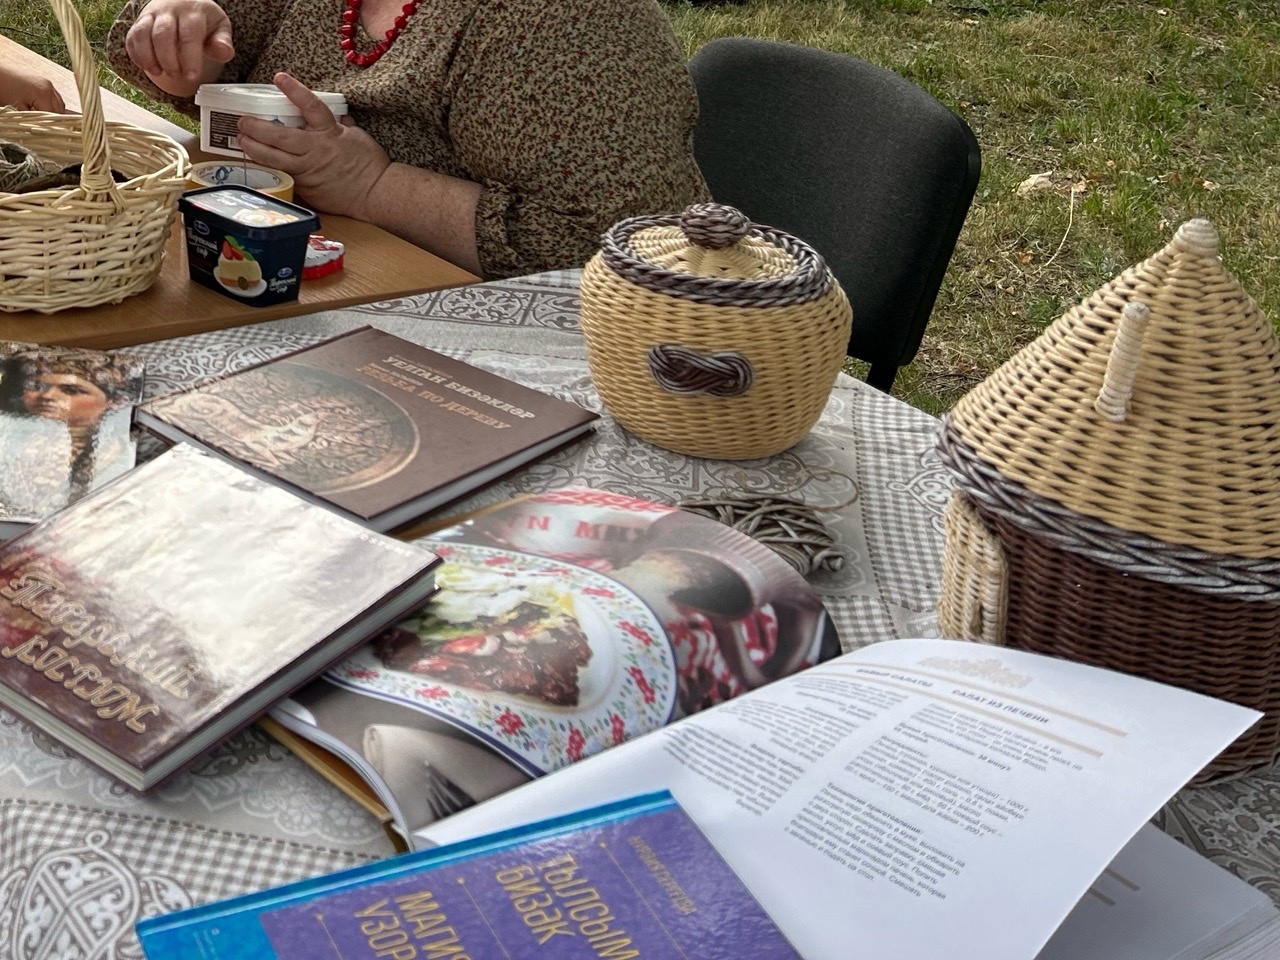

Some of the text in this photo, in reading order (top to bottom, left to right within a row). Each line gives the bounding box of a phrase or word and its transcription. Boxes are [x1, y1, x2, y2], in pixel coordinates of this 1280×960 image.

[417, 390, 445, 403] ПО
[438, 400, 512, 429] ДЕРЕВУ
[952, 689, 1050, 724] САЛАТ ИЗ ПЕЧЕНИ
[394, 890, 473, 960] МАГИ
[536, 852, 640, 960] ТЫЛСЫМ
